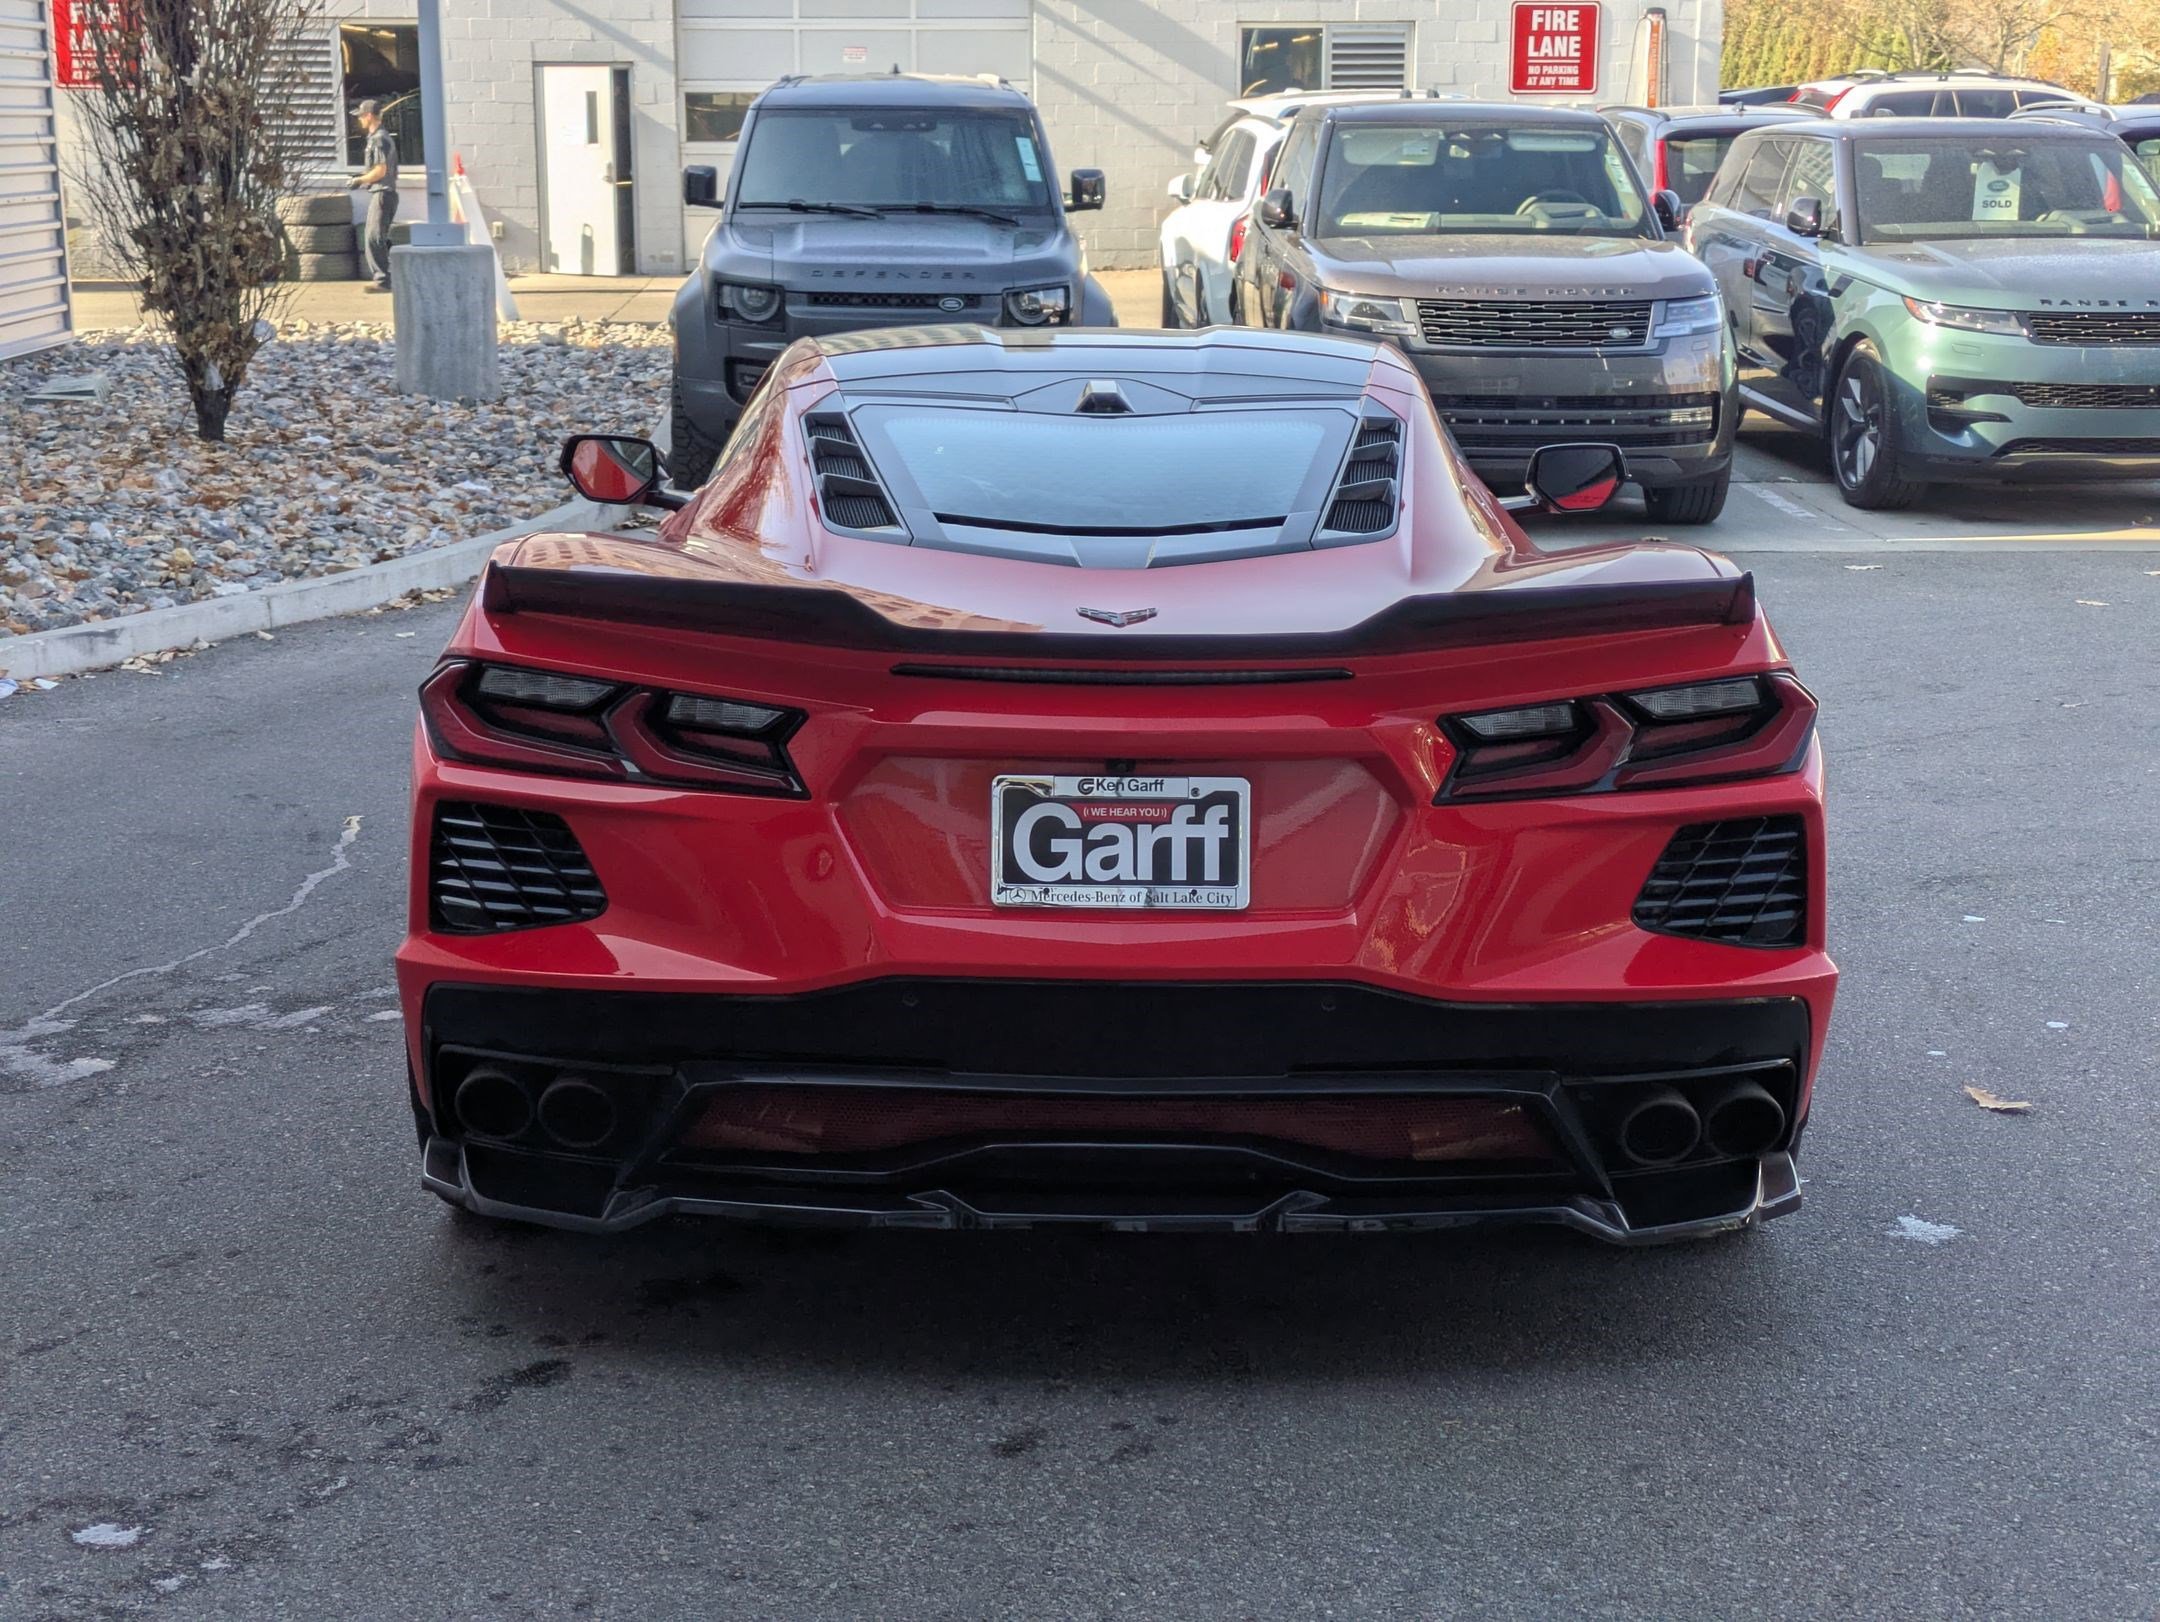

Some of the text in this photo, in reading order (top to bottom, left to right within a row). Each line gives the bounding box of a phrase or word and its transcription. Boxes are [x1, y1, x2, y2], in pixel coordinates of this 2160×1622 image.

[1531, 9, 1580, 31] FIRE
[1527, 35, 1582, 57] LANE
[1528, 65, 1579, 75] NO PARKING
[1526, 76, 1580, 86] AT ANY TIME
[1982, 200, 2012, 209] SOLD
[811, 269, 977, 281] DEFENDER
[1436, 286, 1636, 297] RANGE ROVER
[2040, 299, 2128, 307] RANGE
[1097, 778, 1125, 792] Ken
[1127, 778, 1165, 792] Garff
[1091, 807, 1160, 817] WE HEAR YOU
[1013, 802, 1230, 882] Garff
[1032, 890, 1233, 907] Mercedes-Benz of Salt Lake City
